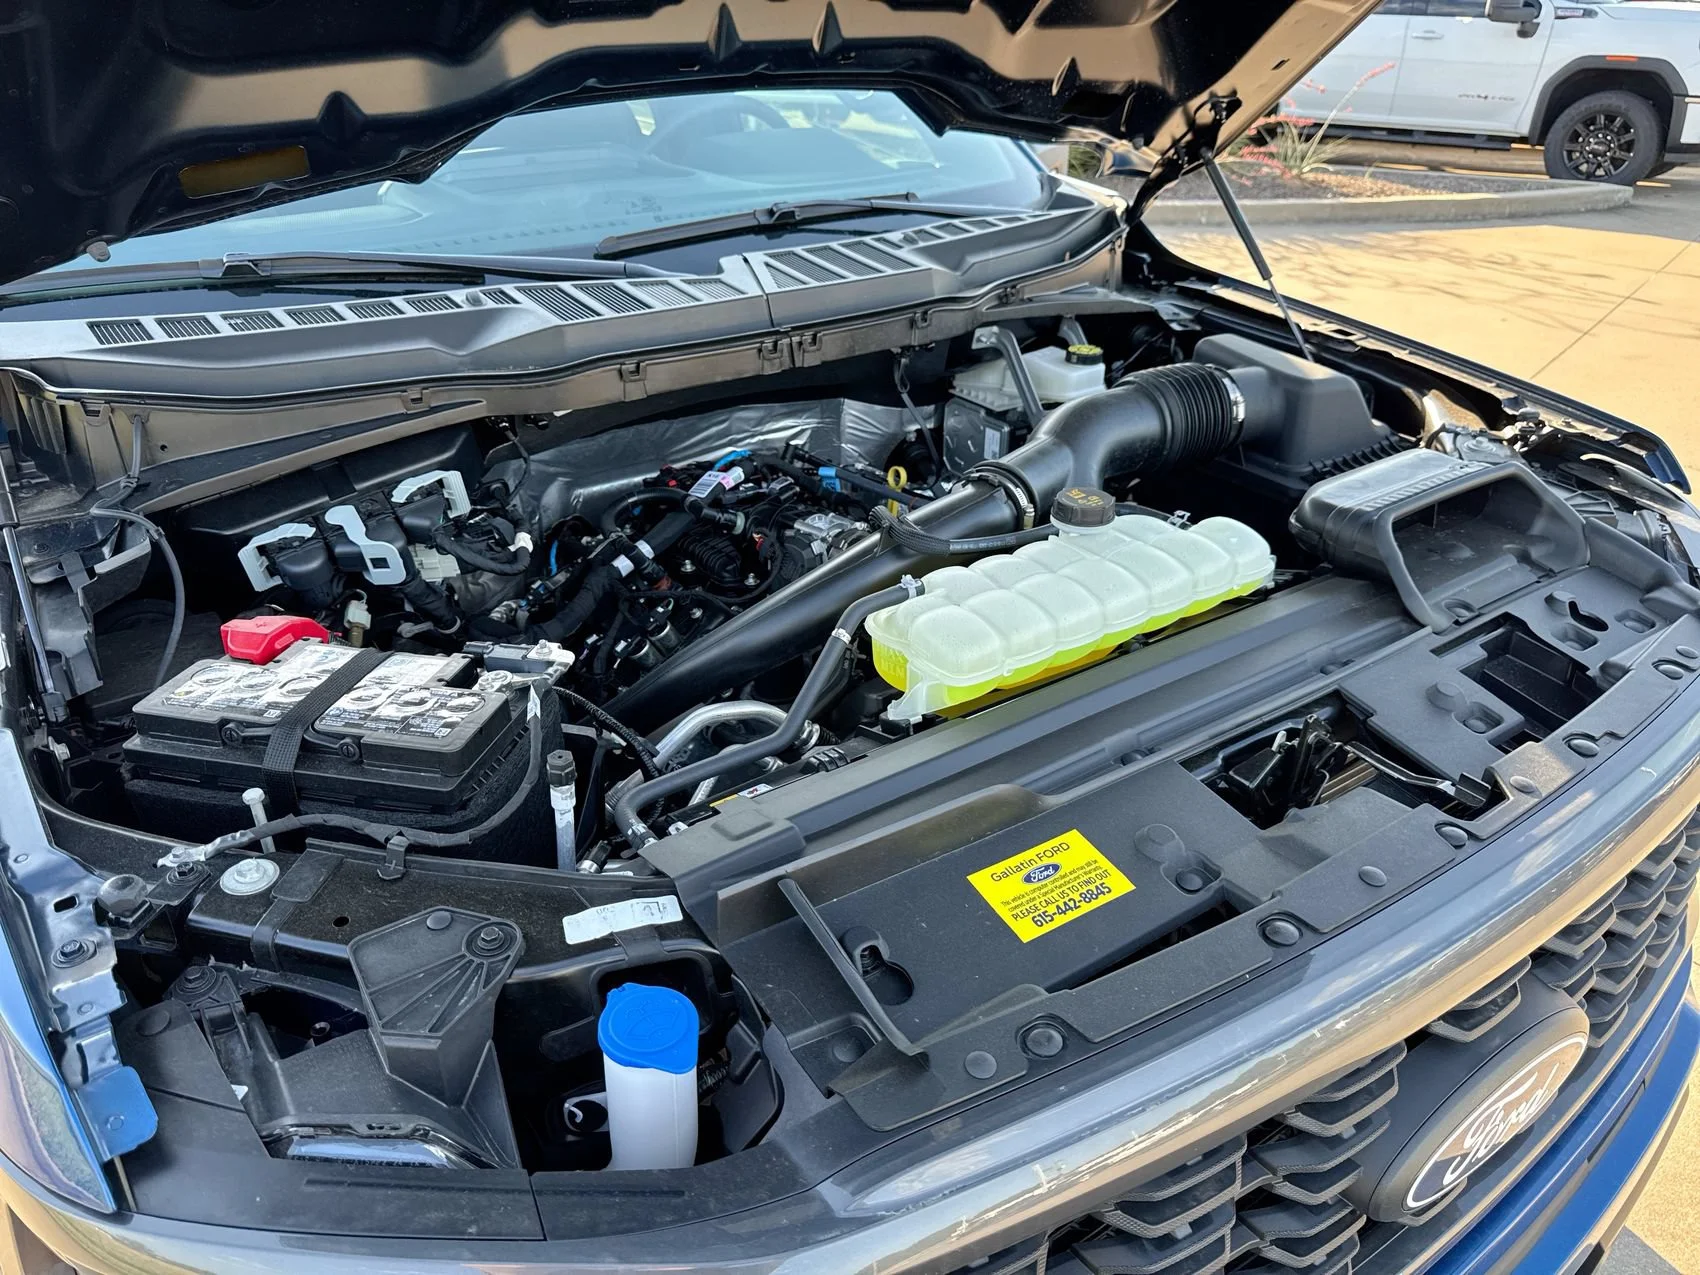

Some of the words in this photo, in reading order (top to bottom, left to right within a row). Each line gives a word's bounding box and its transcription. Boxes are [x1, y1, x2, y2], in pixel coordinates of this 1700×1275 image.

[990, 858, 1038, 882] Gallatin
[1035, 842, 1070, 862] FORD
[1030, 867, 1055, 881] Ford
[1008, 901, 1026, 913] covered
[1025, 896, 1037, 905] under
[1038, 887, 1056, 897] Special
[1053, 873, 1085, 890] Manufacturer's
[1011, 894, 1026, 903] vehicle
[1028, 882, 1049, 895] computer
[1048, 872, 1070, 885] controlled
[1068, 868, 1077, 876] and
[1011, 903, 1042, 921] PLEASE
[1038, 895, 1060, 908] CALL
[1056, 889, 1070, 899] US
[1066, 884, 1080, 894] TO
[1077, 876, 1097, 889] FIND
[1095, 869, 1111, 881] OUT
[1031, 882, 1112, 927] 615-442-8845
[1443, 1063, 1560, 1185] Ford
